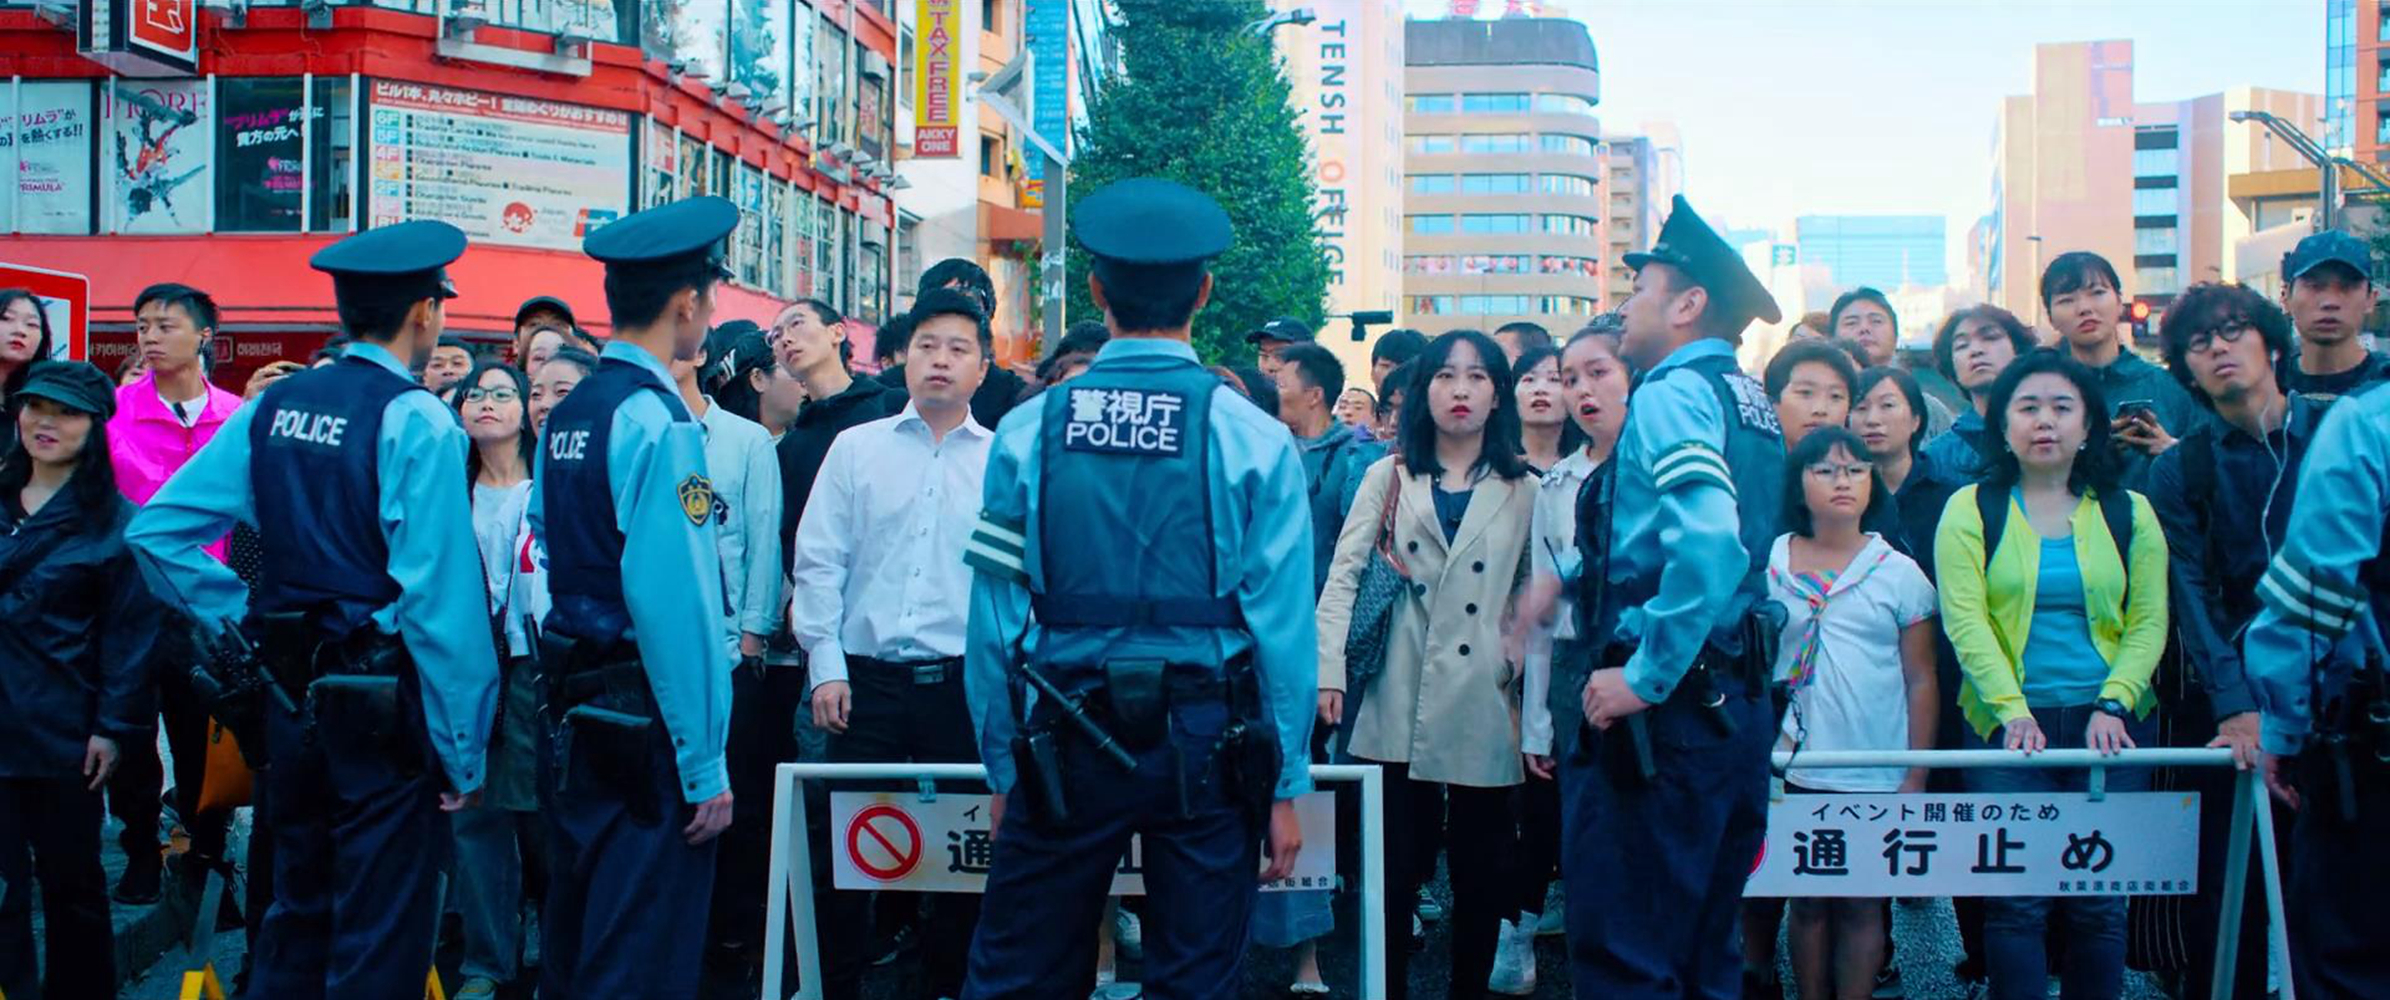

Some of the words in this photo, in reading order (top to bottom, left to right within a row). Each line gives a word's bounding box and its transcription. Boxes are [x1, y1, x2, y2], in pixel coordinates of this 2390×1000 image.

[929, 11, 949, 57] TAX
[928, 61, 948, 121] FREE
[921, 141, 951, 152] ONE
[20, 183, 63, 192] RIMULA
[1071, 389, 1182, 427] 警視庁
[269, 408, 349, 447] POLICE
[1066, 422, 1178, 452] POLICE
[1811, 802, 2061, 823] イベント開催のため
[1793, 827, 2114, 877] 通行止め
